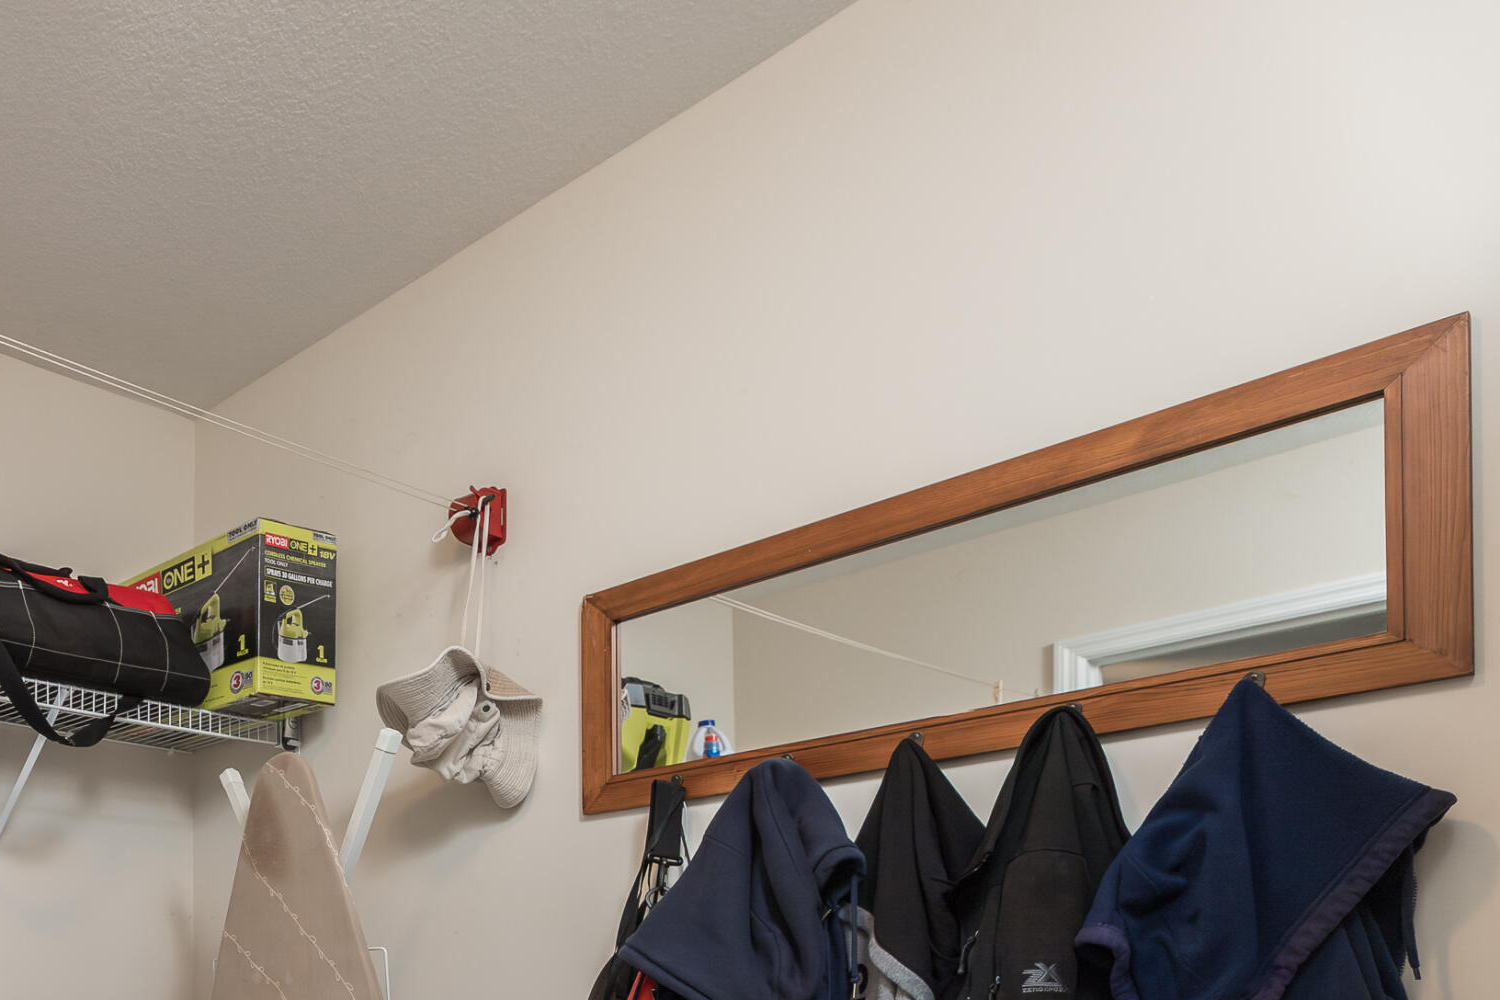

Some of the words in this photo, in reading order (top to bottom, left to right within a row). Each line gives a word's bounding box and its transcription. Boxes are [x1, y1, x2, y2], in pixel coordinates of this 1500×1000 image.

[228, 527, 242, 538] TOOL
[243, 519, 258, 531] ONLY
[265, 534, 288, 548] RYOBI
[319, 550, 336, 560] 18V
[288, 572, 307, 583] GALLONS
[237, 634, 246, 651] 1
[316, 645, 325, 659] 1
[233, 674, 241, 689] 3
[313, 679, 322, 690] 3
